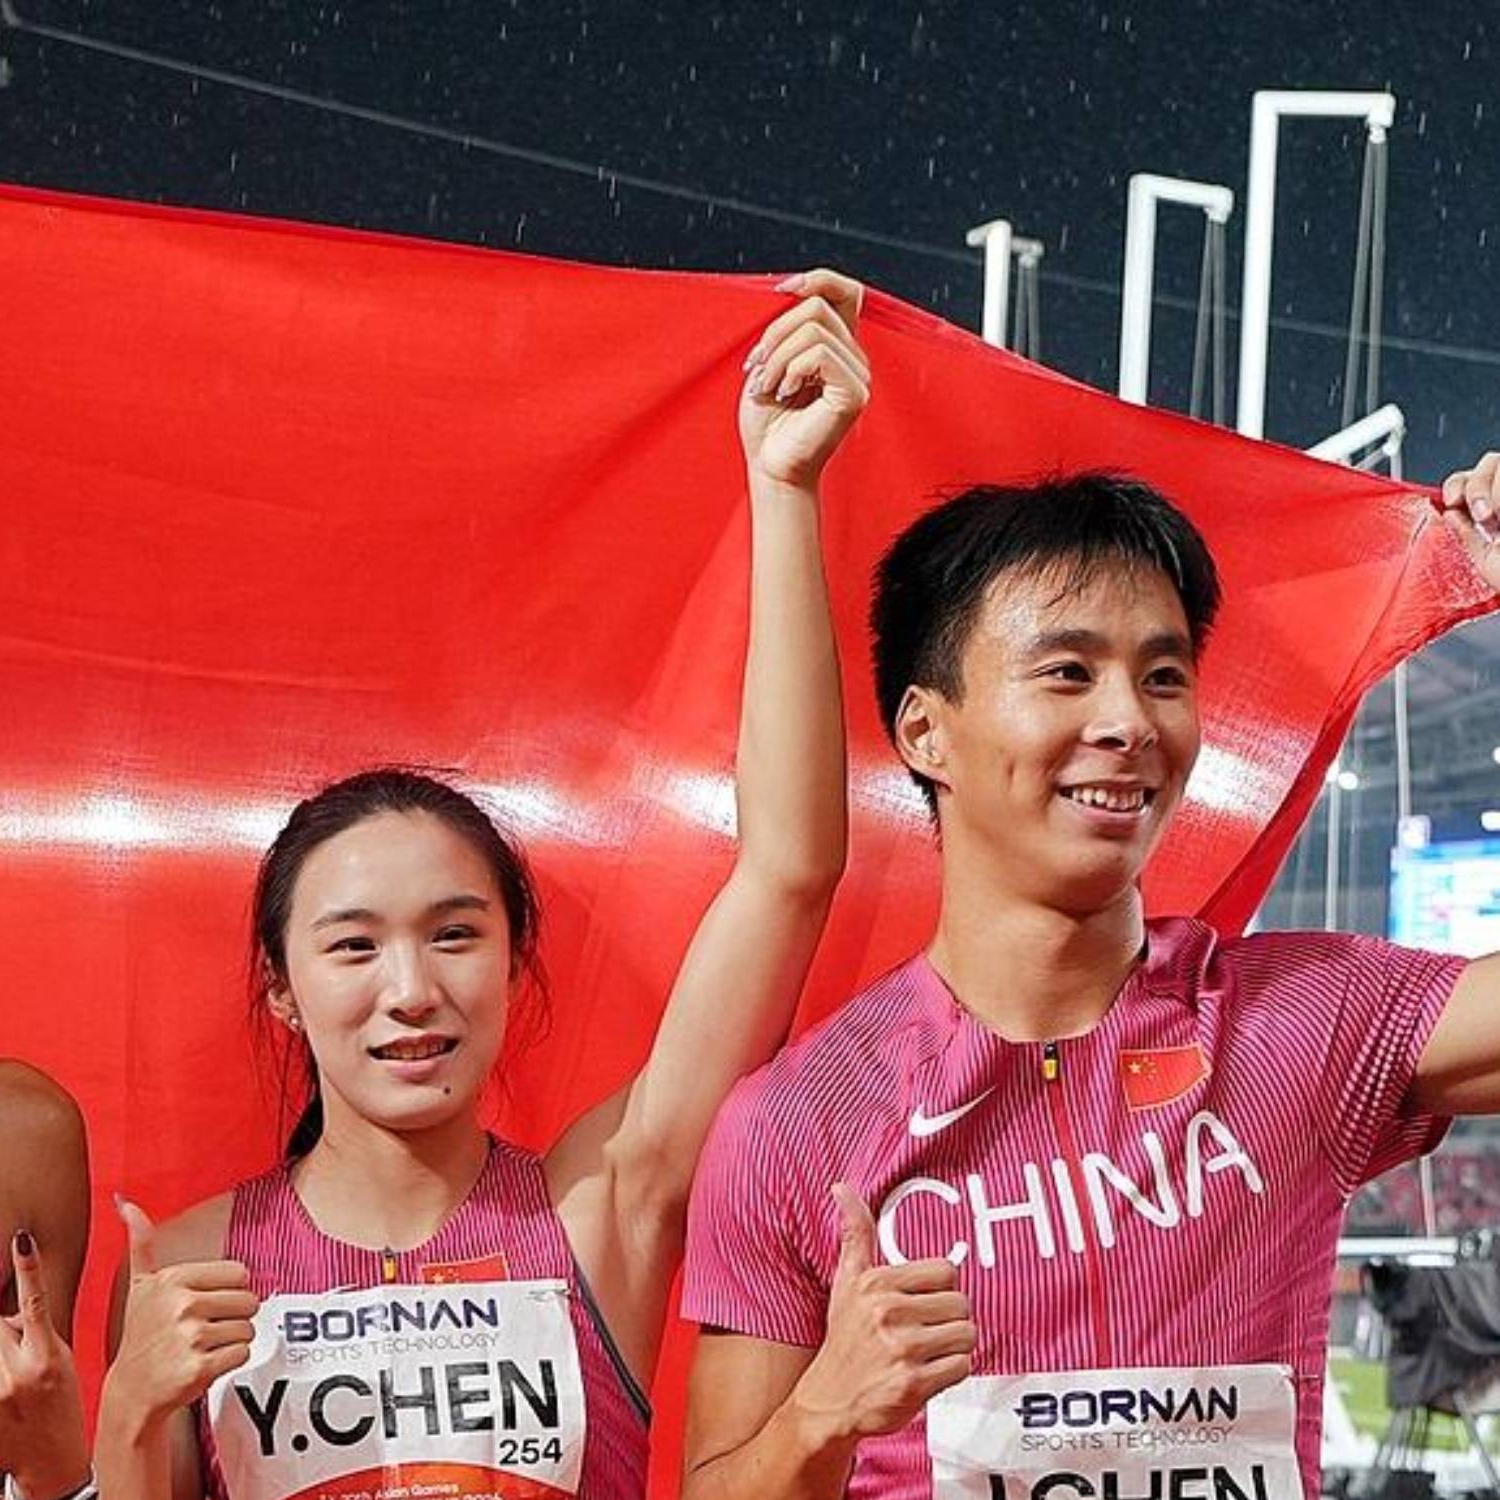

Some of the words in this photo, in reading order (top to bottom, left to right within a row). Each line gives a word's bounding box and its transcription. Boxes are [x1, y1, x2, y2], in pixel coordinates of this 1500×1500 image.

[878, 1110, 1265, 1269] CHINA
[278, 1298, 499, 1343] BORNAN
[287, 1345, 363, 1365] SPORTS
[370, 1332, 500, 1357] TECHNOLOGY
[233, 1359, 560, 1457] Y.CHEN
[1014, 1384, 1238, 1428] BORNAN
[499, 1437, 563, 1465] 254
[1021, 1432, 1102, 1452] SPORTS
[1112, 1426, 1232, 1451] TECHNOLOGY
[375, 1487, 408, 1500] Asian
[411, 1483, 459, 1496] Games
